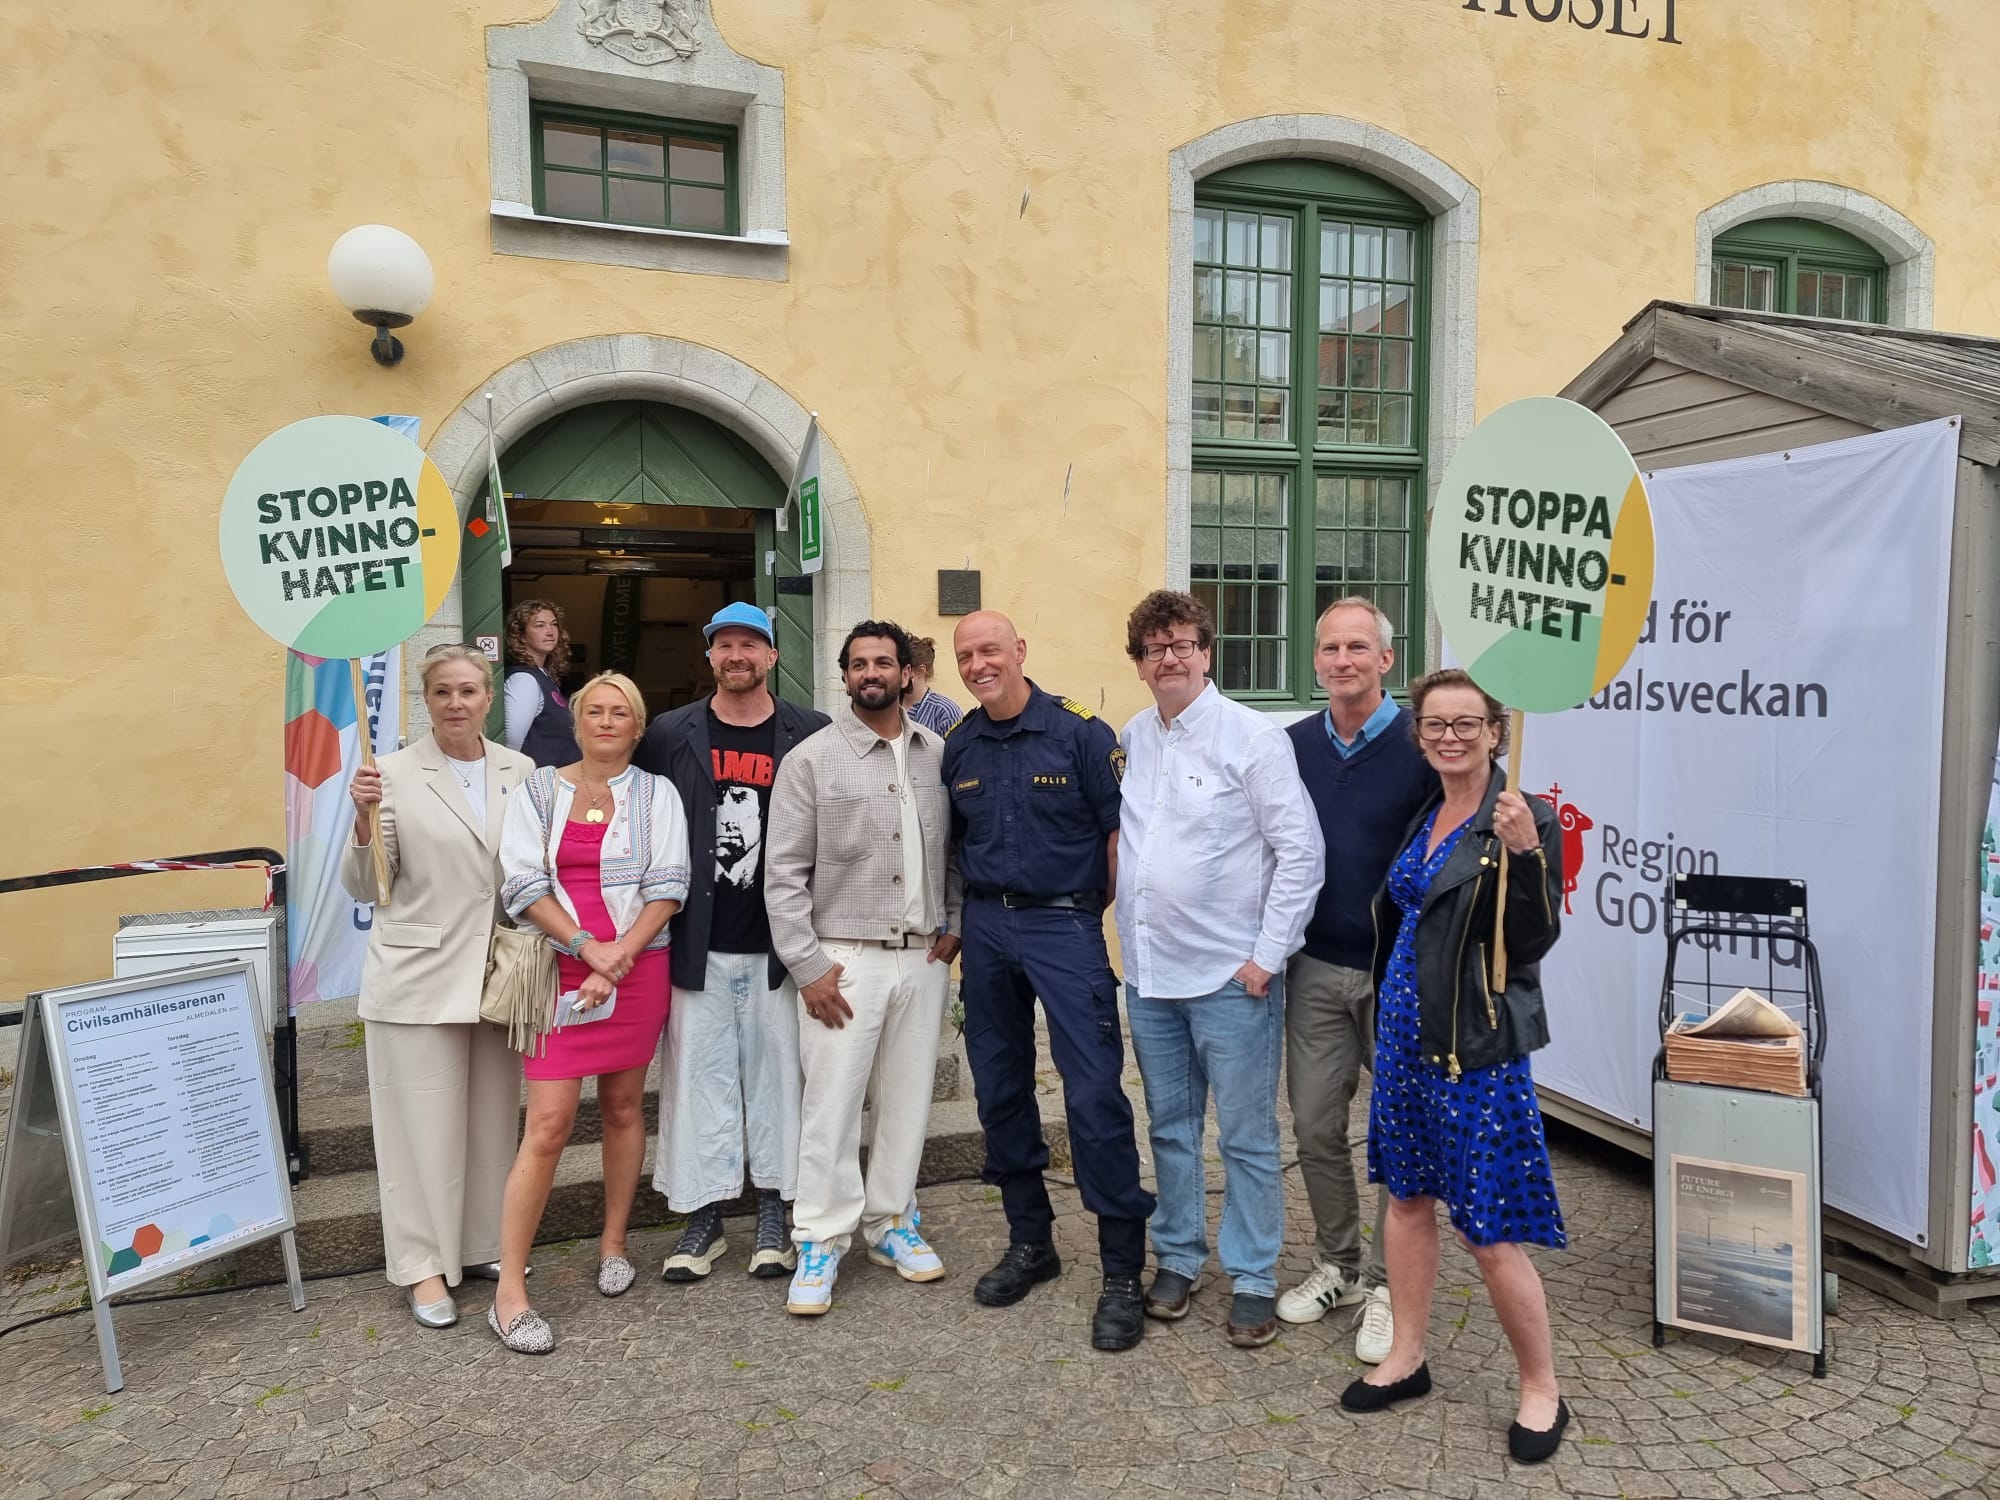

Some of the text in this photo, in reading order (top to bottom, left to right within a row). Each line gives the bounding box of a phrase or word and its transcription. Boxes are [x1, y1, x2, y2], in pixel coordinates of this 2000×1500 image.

[257, 477, 417, 524] STOPPA
[1464, 484, 1613, 540] STOPPA
[258, 516, 436, 565] KVINNO-
[1459, 532, 1627, 592] KVINNO-
[281, 556, 411, 602] HATET
[1469, 582, 1592, 642] HATET
[1670, 599, 1732, 644] för
[1573, 668, 1828, 717] dalsveckan
[1033, 775, 1068, 785] POLIS
[1602, 824, 1719, 883] Region
[65, 1005, 107, 1019] PROGRAM
[66, 992, 226, 1033] Civilsamhällesarenan
[186, 1007, 227, 1022] ALMEDALEN
[73, 1053, 97, 1063] Onsdag
[167, 1033, 190, 1042] Torsdag
[1680, 1174, 1721, 1187] FUTURE
[1680, 1182, 1695, 1191] OF
[1696, 1184, 1736, 1198] ENERGY
